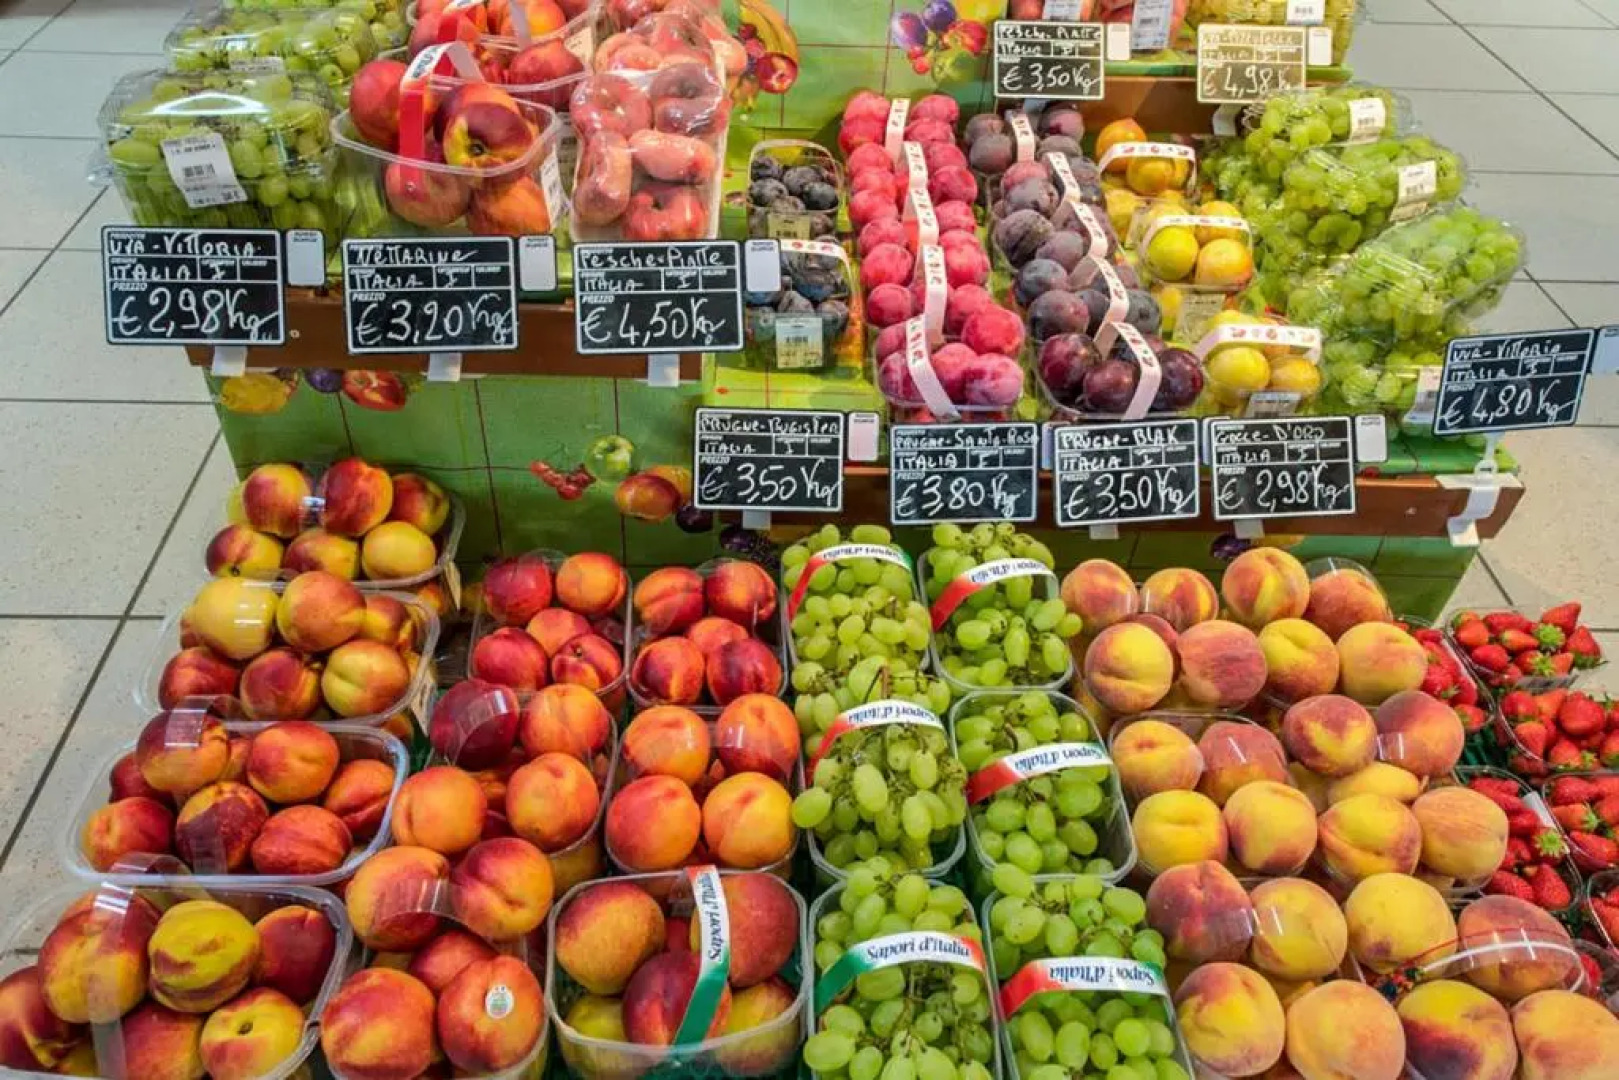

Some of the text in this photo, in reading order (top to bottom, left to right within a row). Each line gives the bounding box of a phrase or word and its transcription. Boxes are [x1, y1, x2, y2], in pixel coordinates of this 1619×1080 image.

[867, 935, 970, 960] Sapori d'Italia
[1050, 965, 1106, 983] d'Italia
